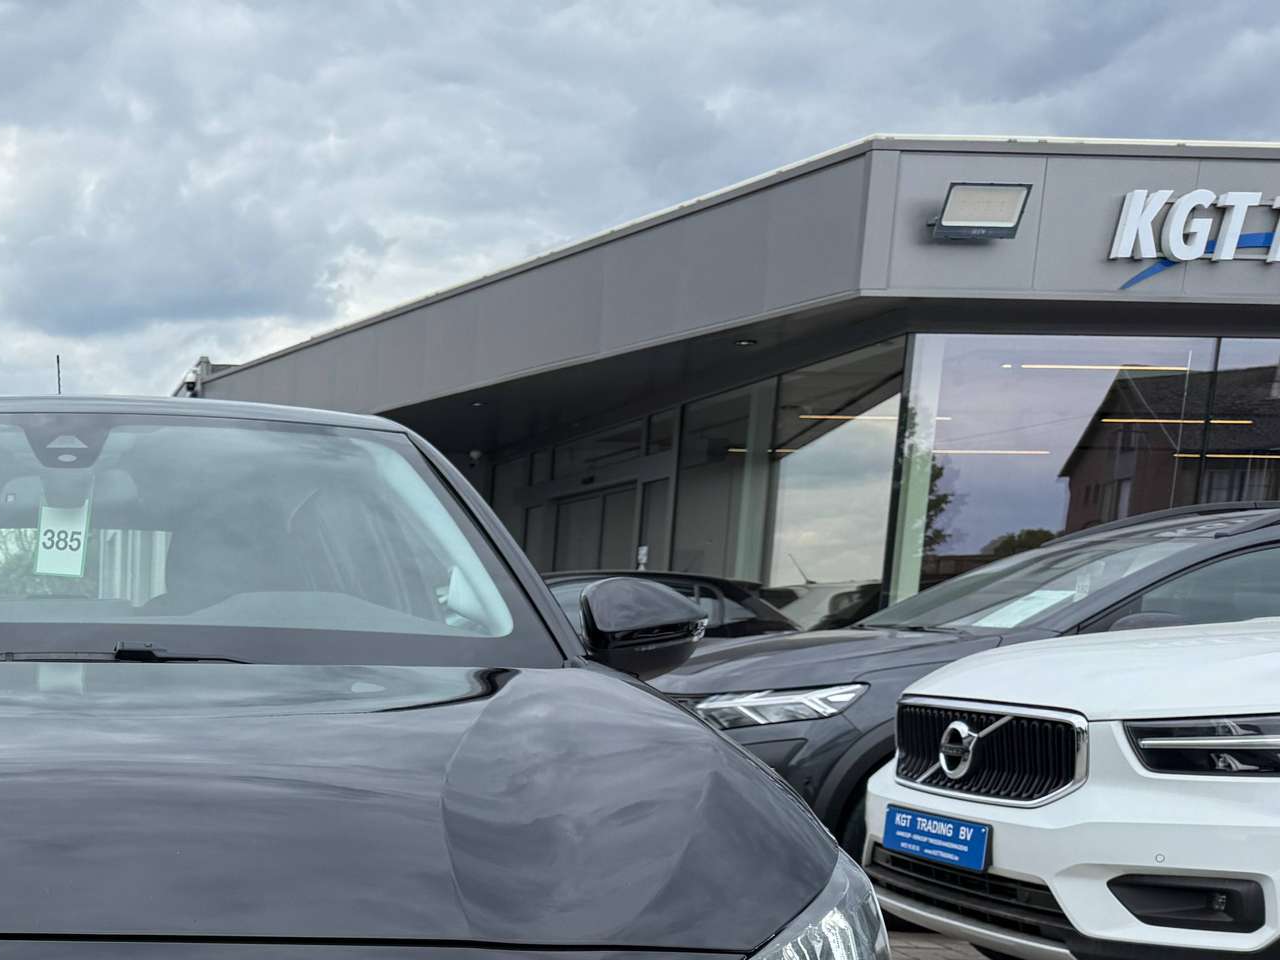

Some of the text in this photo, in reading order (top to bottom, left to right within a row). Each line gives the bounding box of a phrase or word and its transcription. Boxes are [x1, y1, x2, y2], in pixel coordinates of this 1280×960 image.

[1108, 188, 1263, 262] KGT
[41, 528, 82, 552] 385
[894, 813, 912, 827] KGT
[916, 817, 953, 837] TRADING
[958, 826, 974, 841] BV
